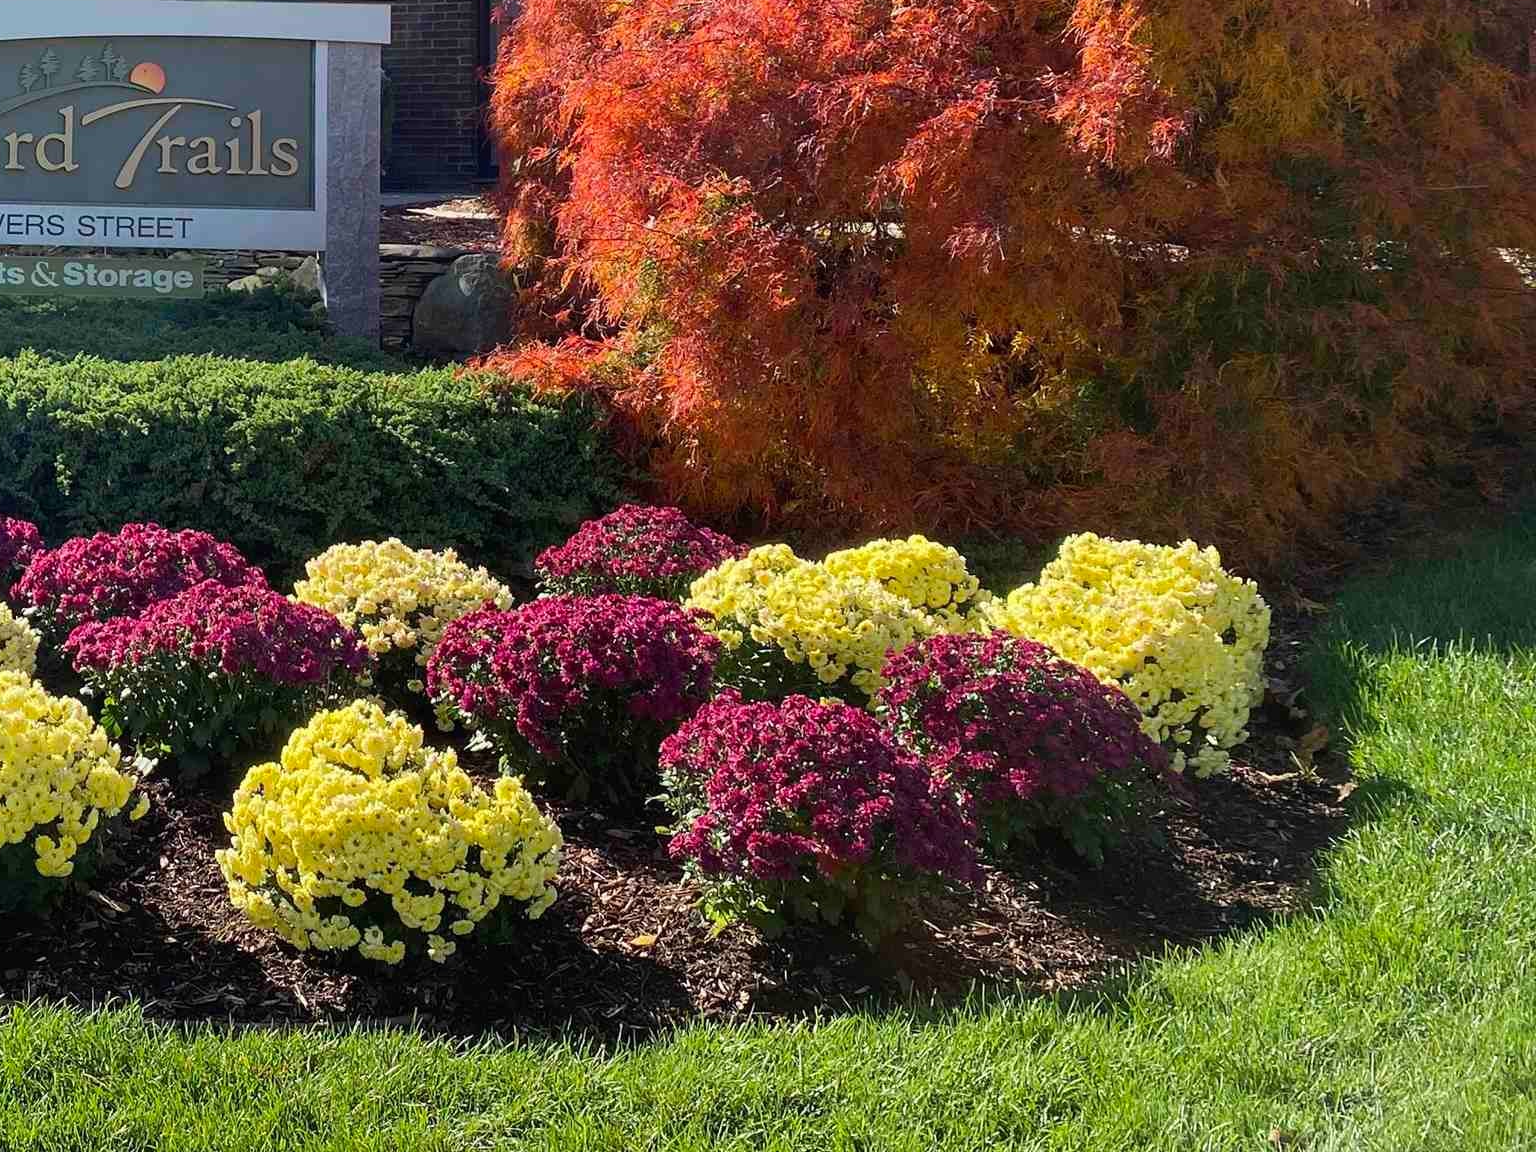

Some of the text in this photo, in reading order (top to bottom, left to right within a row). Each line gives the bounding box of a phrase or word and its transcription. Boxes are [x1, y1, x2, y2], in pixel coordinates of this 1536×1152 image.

[81, 96, 299, 190] Trails
[77, 214, 194, 240] STREET
[31, 261, 60, 288] &
[63, 261, 194, 295] Storage
